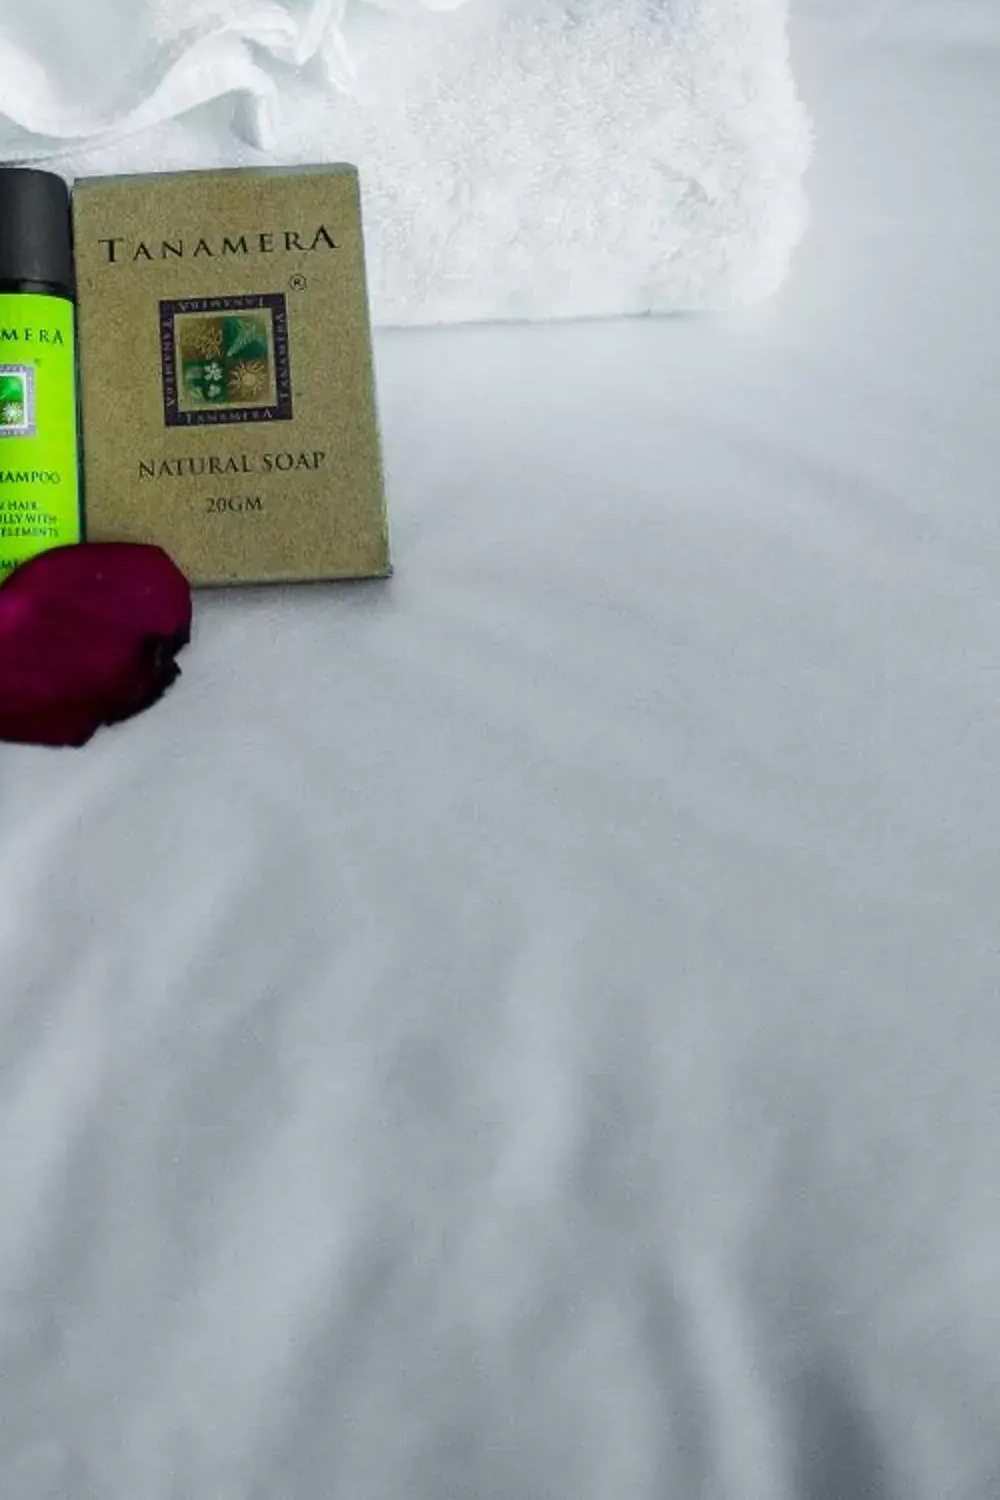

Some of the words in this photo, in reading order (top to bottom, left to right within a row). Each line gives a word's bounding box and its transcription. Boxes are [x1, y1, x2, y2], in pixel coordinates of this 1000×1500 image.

[98, 225, 341, 263] TANAMERA
[138, 454, 252, 478] NATURAL
[262, 451, 326, 473] SOAP
[206, 498, 263, 514] 20GM
